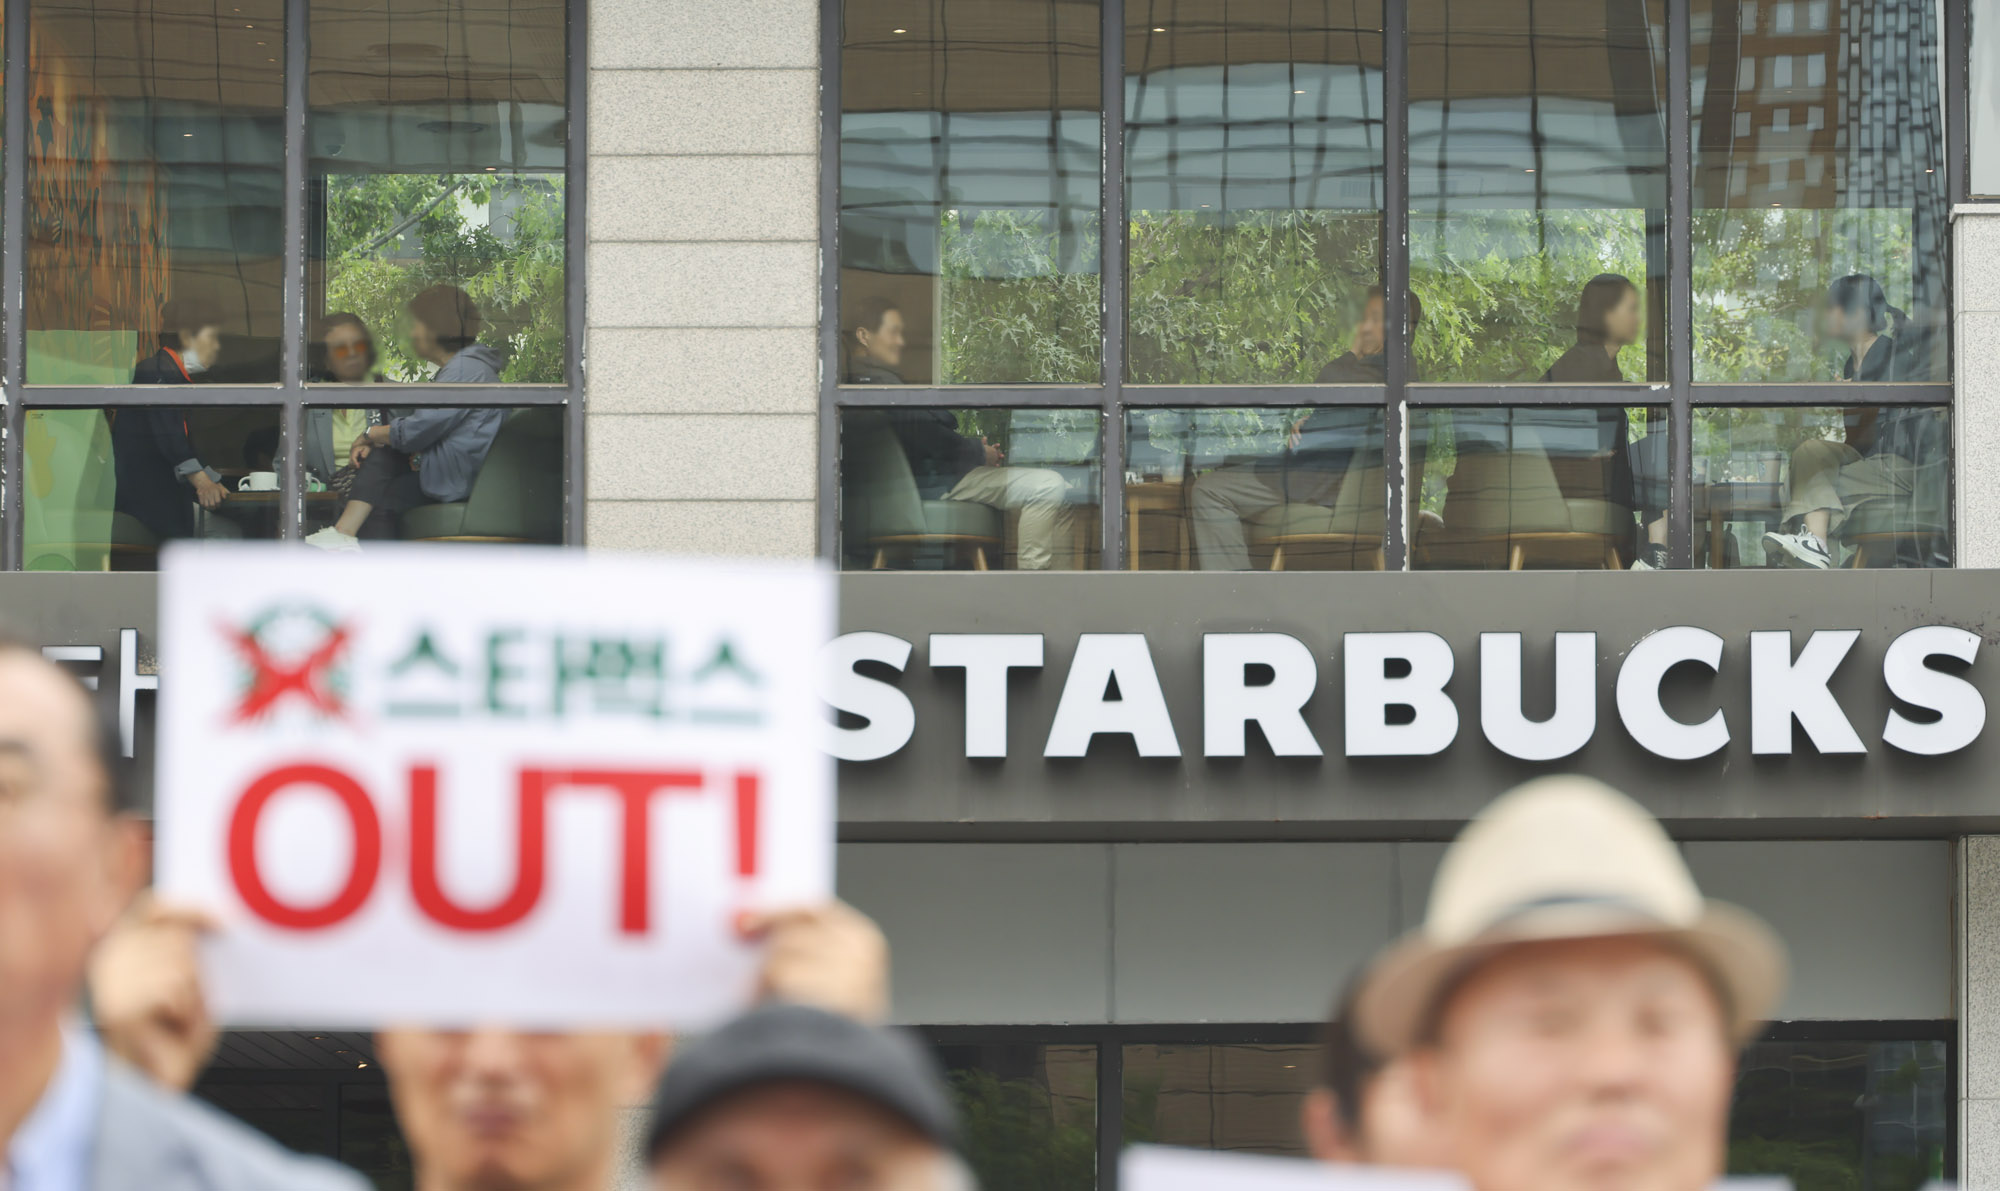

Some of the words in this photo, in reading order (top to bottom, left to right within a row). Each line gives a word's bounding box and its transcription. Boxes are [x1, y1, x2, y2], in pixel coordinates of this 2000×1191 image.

[384, 627, 764, 729] 스타벅스
[817, 625, 1986, 761] STARBUCKS
[227, 762, 760, 933] OUT!
